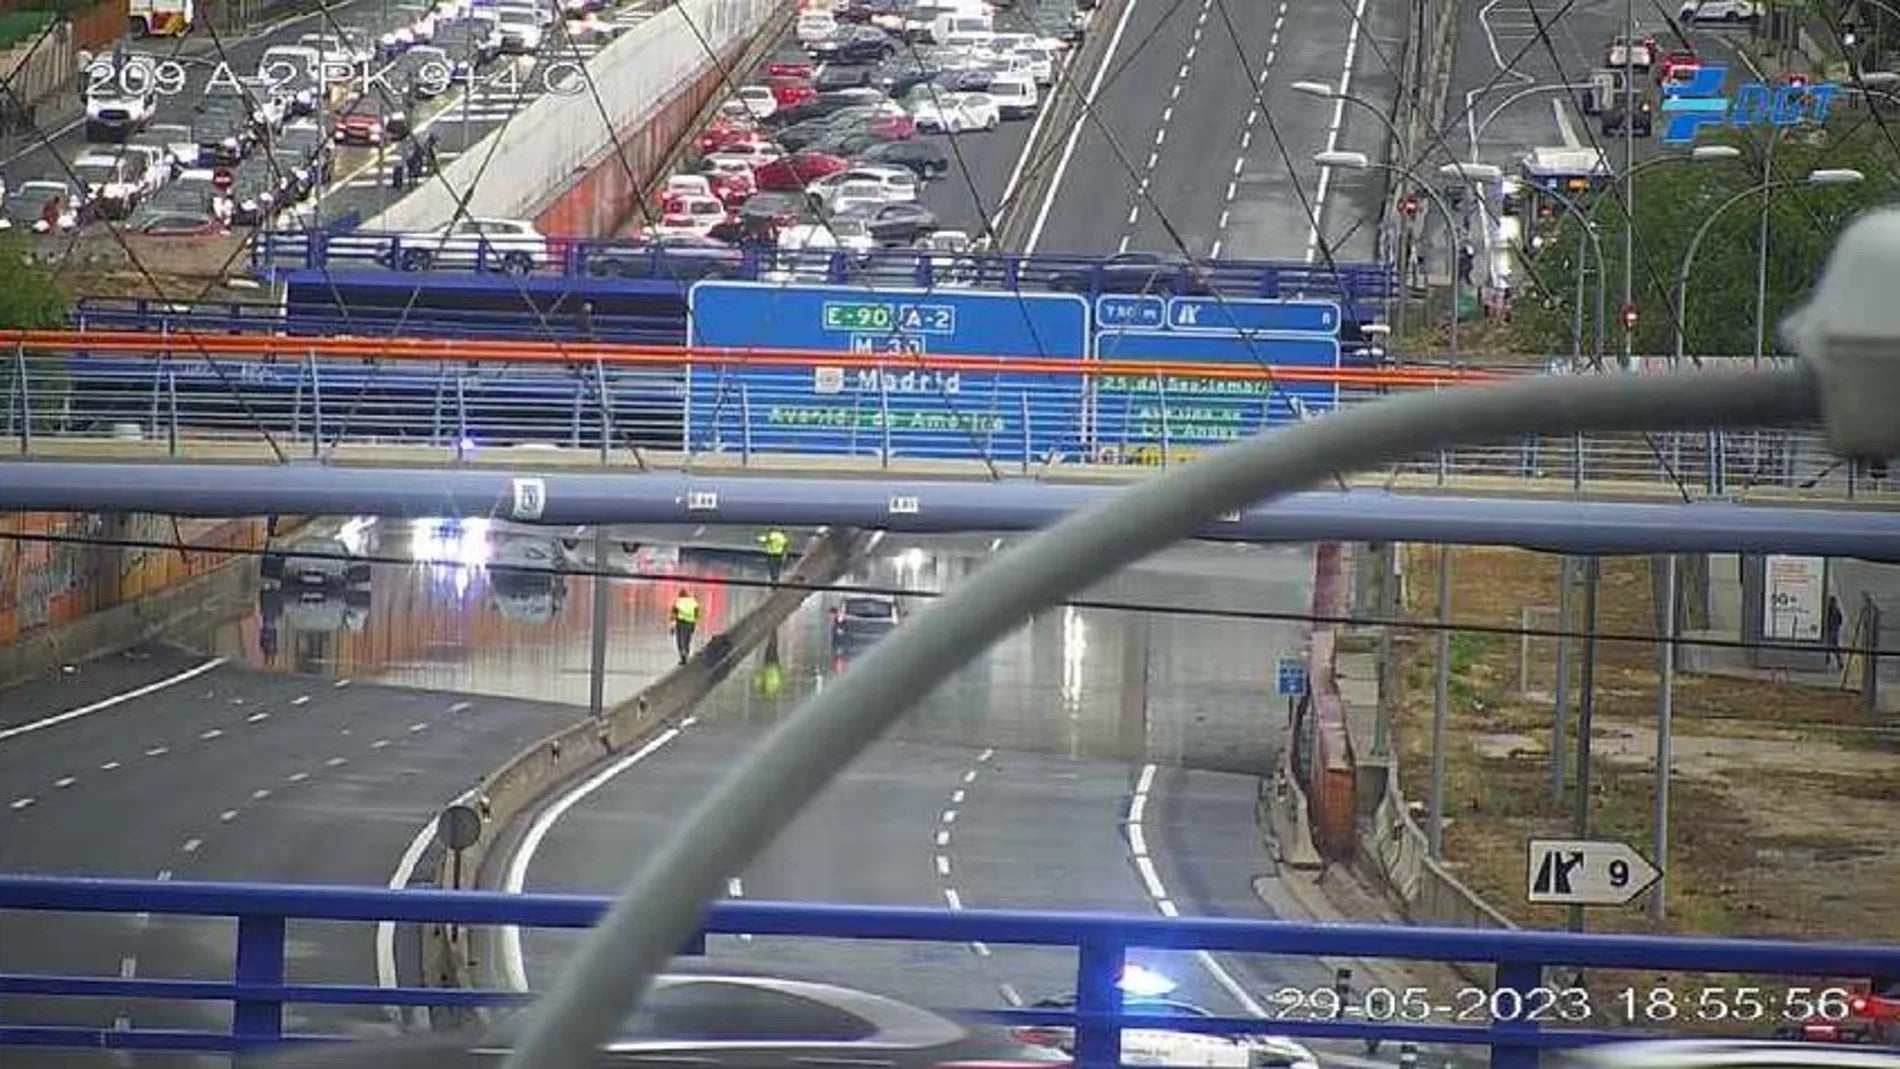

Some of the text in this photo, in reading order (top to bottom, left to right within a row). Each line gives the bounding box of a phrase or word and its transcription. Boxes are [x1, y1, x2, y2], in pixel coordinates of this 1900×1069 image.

[827, 306, 950, 328] E-90 A-2
[857, 368, 960, 393] Madrid
[1608, 859, 1630, 887] 9
